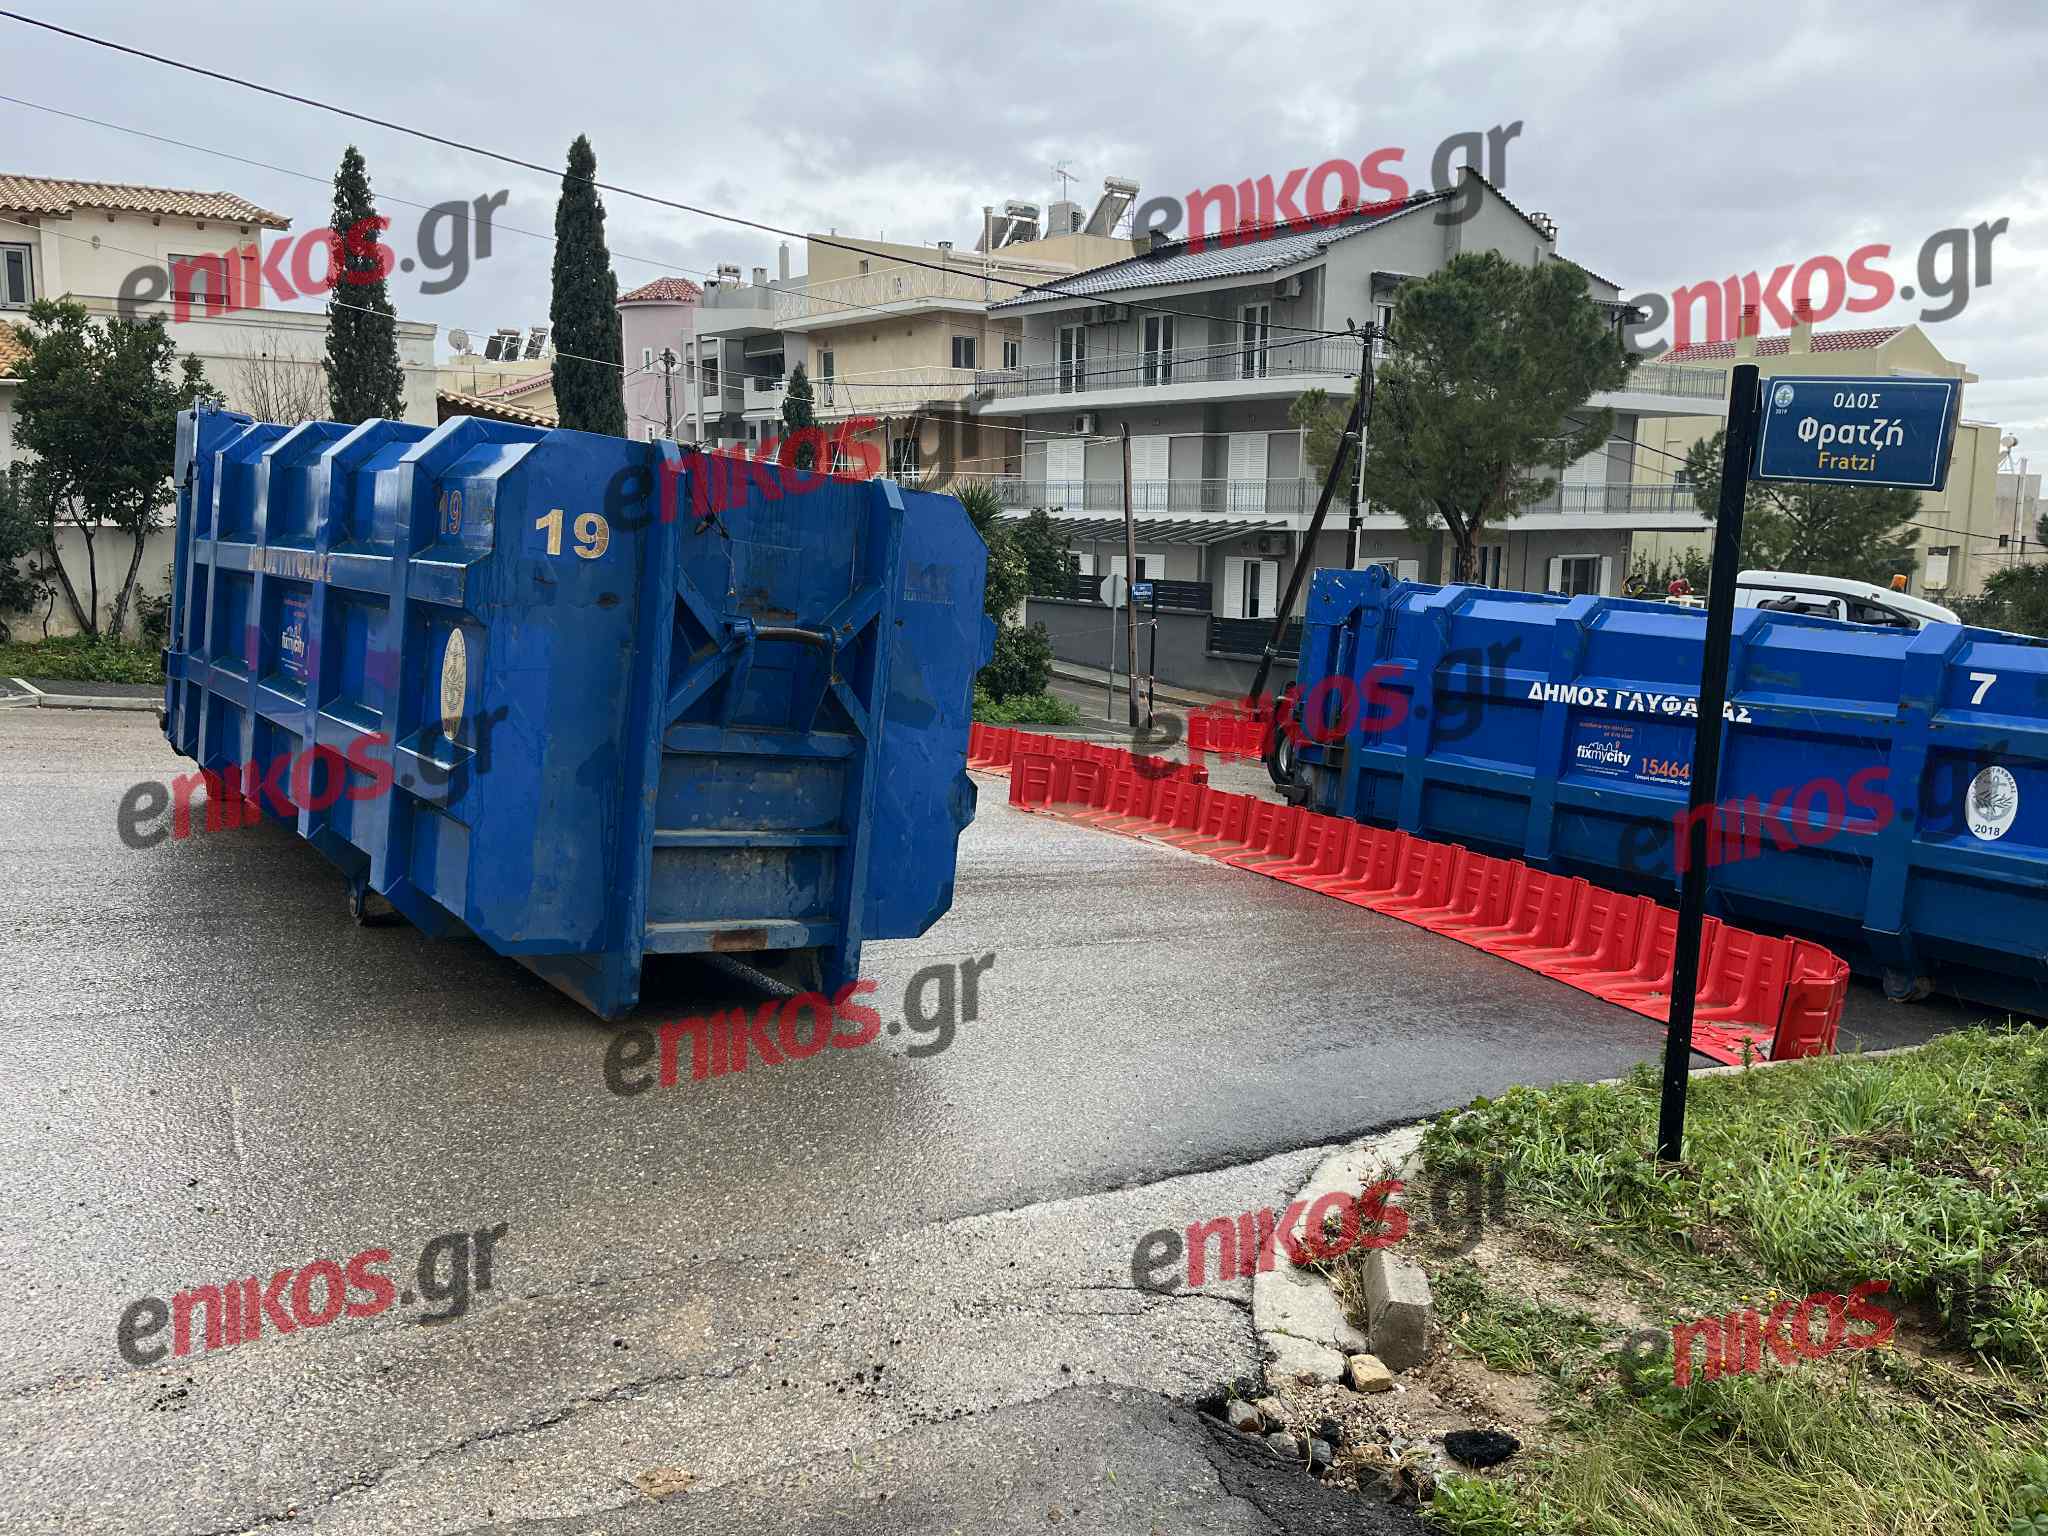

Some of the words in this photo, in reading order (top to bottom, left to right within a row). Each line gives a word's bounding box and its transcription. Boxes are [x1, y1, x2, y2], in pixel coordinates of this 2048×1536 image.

[1833, 392, 1881, 409] ΟΔΟΣ
[1797, 416, 1905, 451] Φρατζή
[1817, 451, 1877, 472] Fratzi
[438, 489, 463, 536] 19
[535, 508, 610, 560] 19
[1969, 672, 1997, 705] 7
[1527, 682, 1608, 708] ΔΗΜΟΣ
[1614, 690, 1753, 724] ΓΛΥΦΑΑΣ
[1576, 744, 1631, 767] fixmycity
[1641, 757, 1690, 778] 15464
[1973, 823, 2001, 837] 2018
